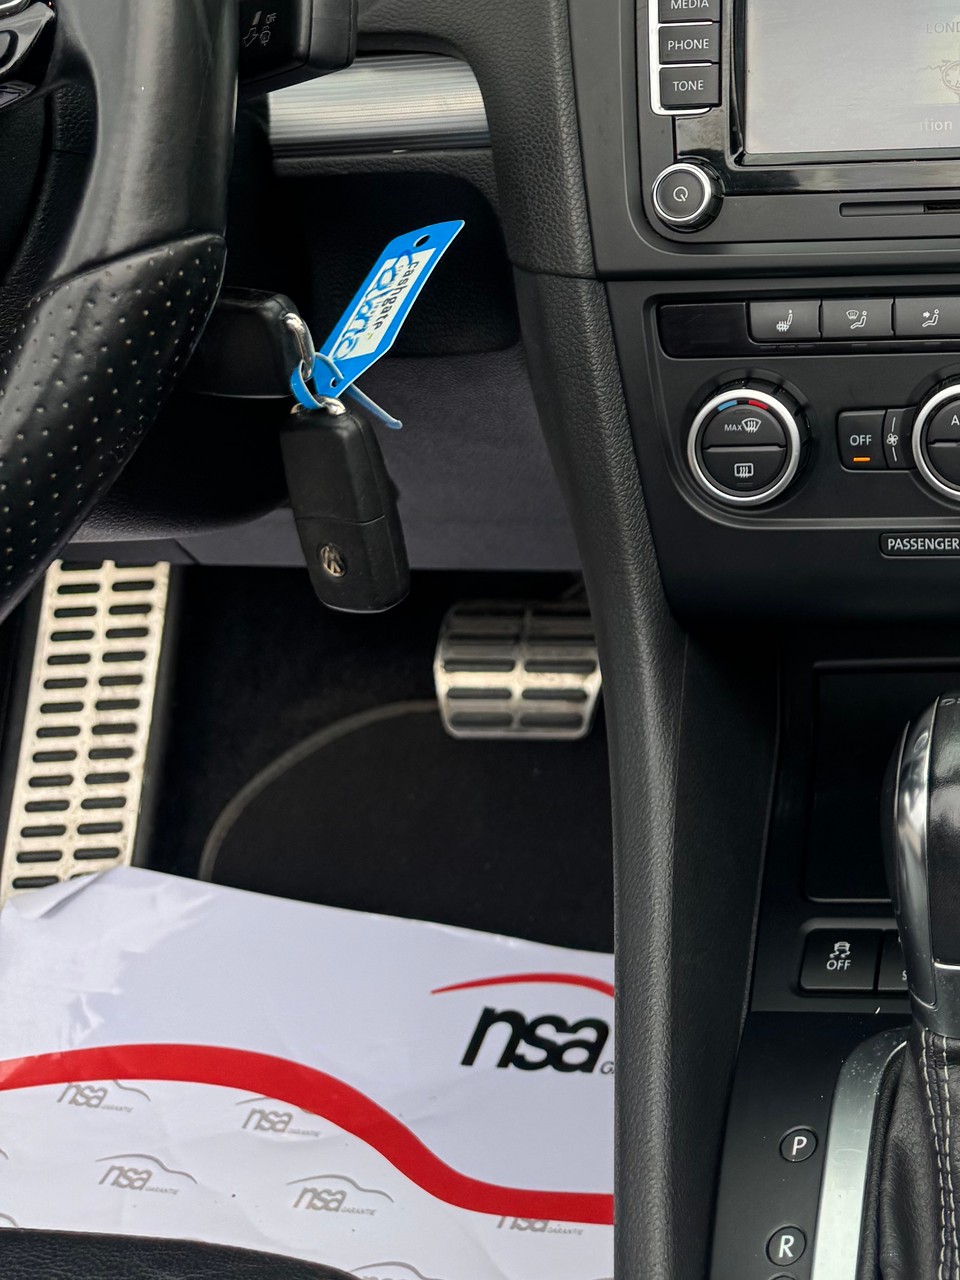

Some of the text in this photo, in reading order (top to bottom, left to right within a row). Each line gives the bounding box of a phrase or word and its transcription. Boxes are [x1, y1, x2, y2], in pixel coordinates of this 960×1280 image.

[667, 39, 710, 51] PHONE
[672, 80, 704, 91] TONE
[724, 423, 742, 432] MAX
[849, 434, 872, 446] OFF
[888, 538, 960, 551] PASSENGER
[826, 959, 852, 971] OFF
[461, 1005, 610, 1073] nsa
[57, 1083, 108, 1108] nsa
[242, 1108, 293, 1133] nsa
[790, 1135, 808, 1156] P
[99, 1164, 153, 1191] nsa
[293, 1186, 347, 1212] nsa
[778, 1234, 795, 1258] R
